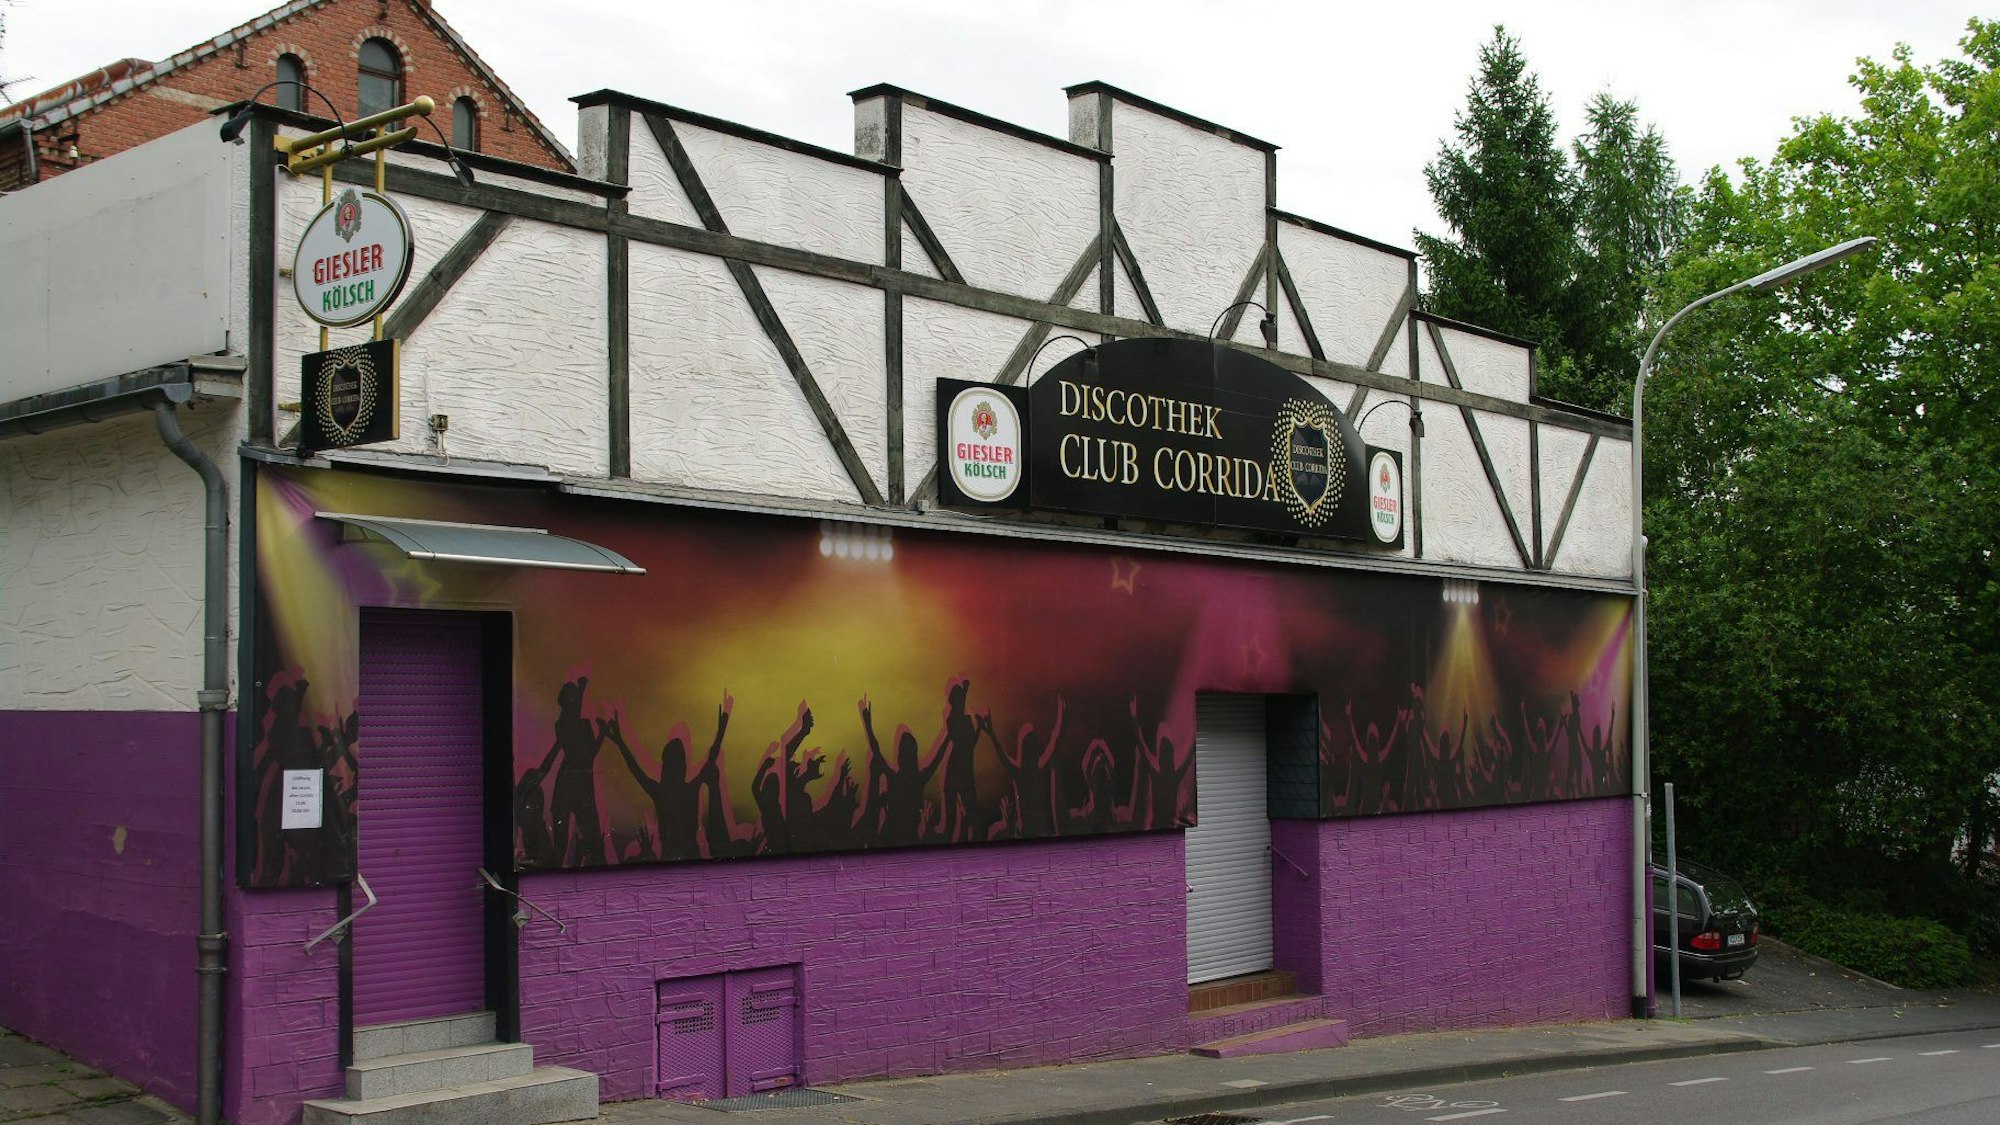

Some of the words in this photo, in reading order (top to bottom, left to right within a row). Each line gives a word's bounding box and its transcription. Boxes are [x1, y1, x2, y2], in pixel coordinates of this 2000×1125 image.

[313, 243, 384, 285] GIESLER
[322, 280, 375, 312] KÖLSCH
[1059, 380, 1223, 439] DISCOTHEK
[957, 443, 1014, 464] GIESLER
[1060, 433, 1139, 484] CLUB
[1154, 447, 1281, 502] CORRIDA
[964, 462, 1007, 479] KÖLSCH
[1373, 496, 1397, 513] GIESLER
